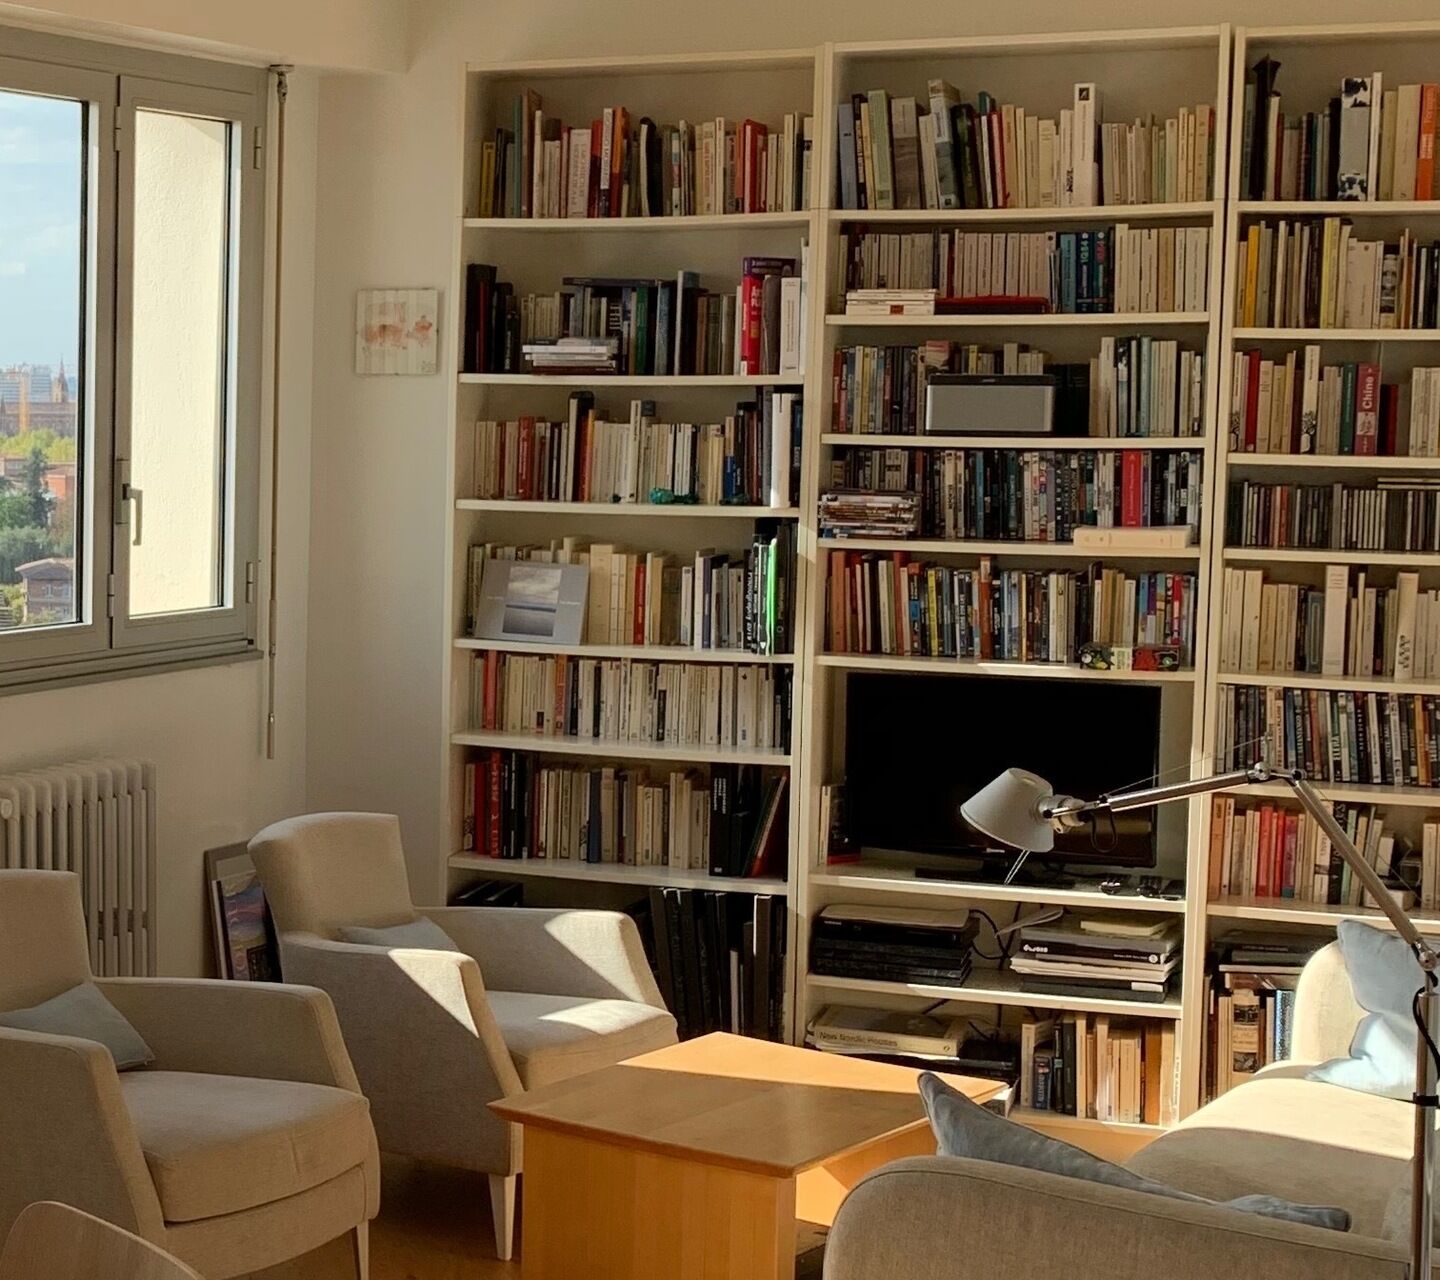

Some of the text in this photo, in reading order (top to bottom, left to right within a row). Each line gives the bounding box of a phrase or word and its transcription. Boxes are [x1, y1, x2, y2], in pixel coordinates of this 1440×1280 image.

[1081, 240, 1089, 263] 1Q84
[1362, 375, 1374, 409] Chine
[819, 1031, 898, 1047] New Nordic Houses
